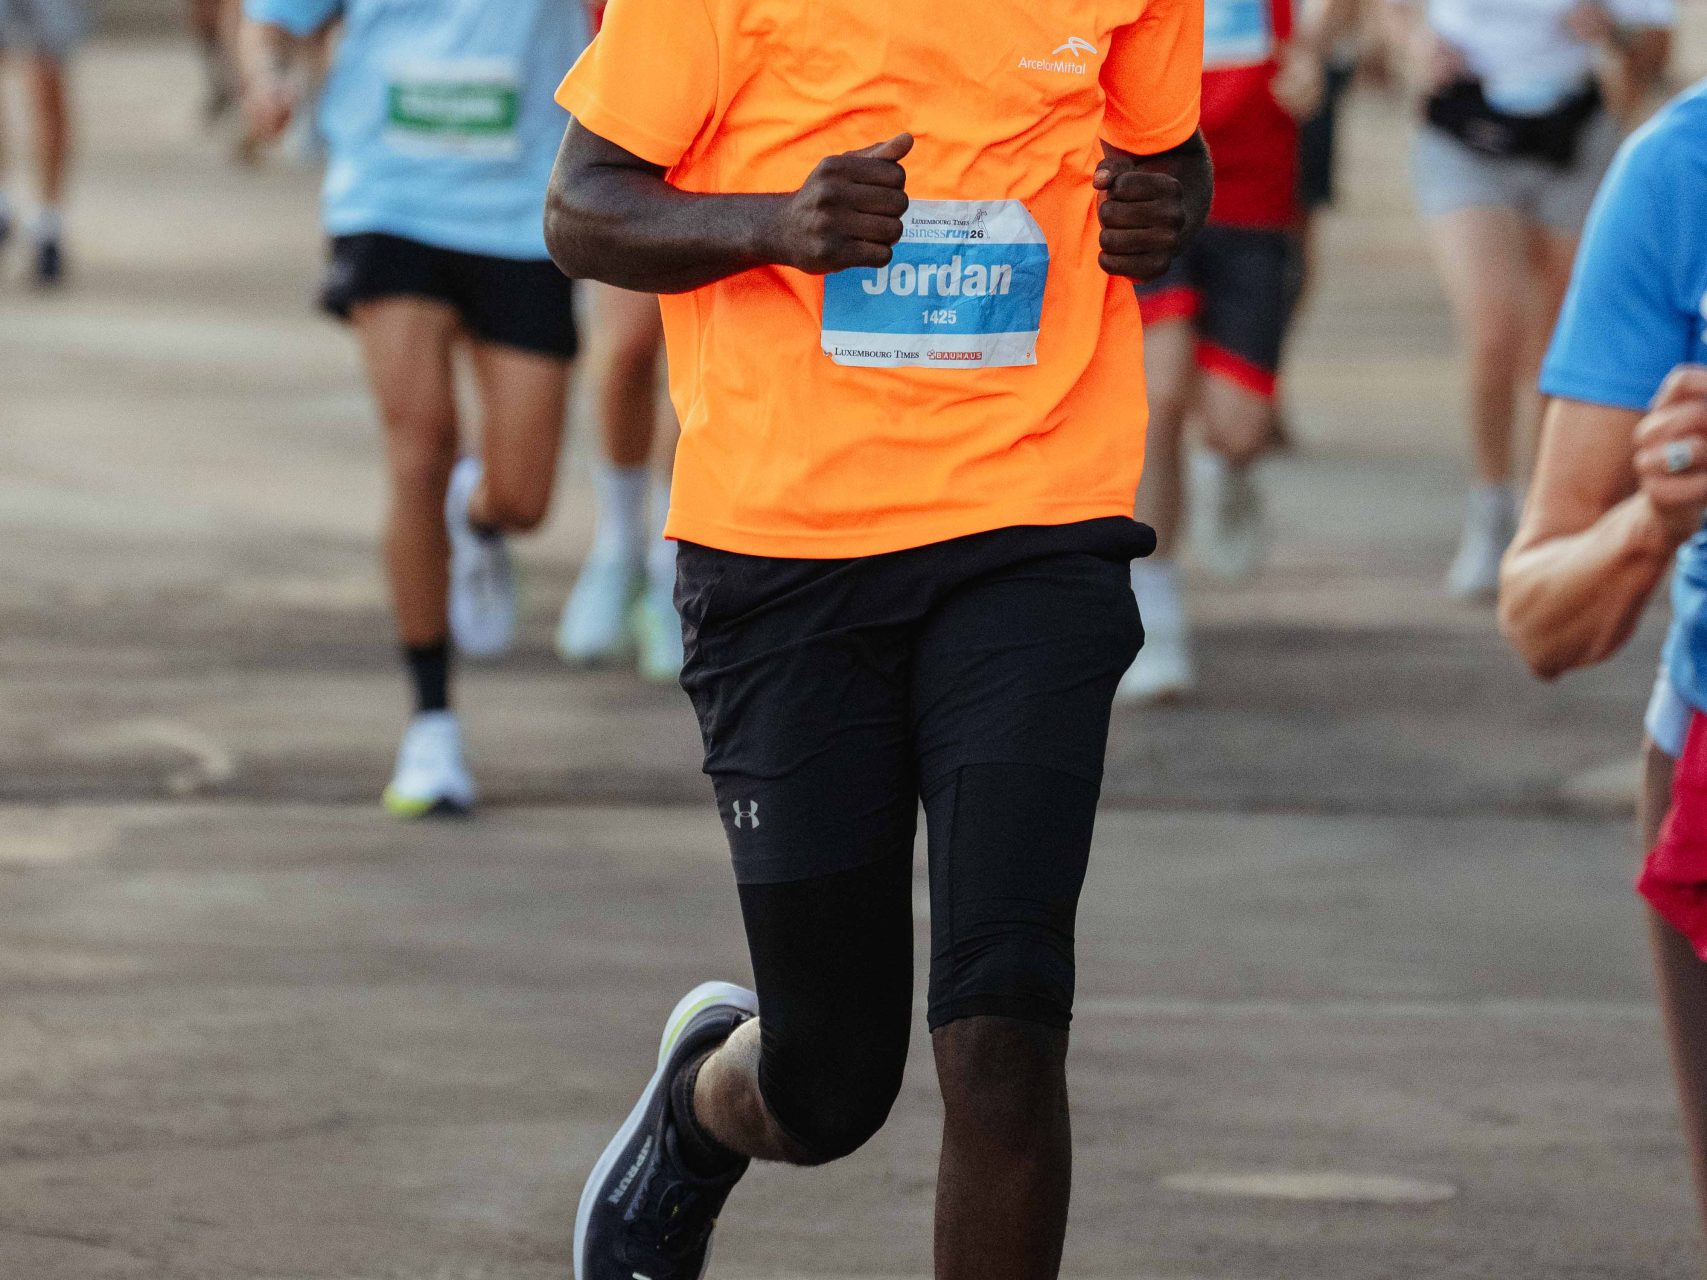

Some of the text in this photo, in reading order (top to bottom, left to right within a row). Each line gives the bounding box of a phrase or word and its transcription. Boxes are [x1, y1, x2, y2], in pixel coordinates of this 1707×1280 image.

[1018, 57, 1086, 75] ArcelorMittal
[902, 225, 984, 239] usinessrun26
[862, 255, 1012, 297] Jordan
[922, 310, 957, 324] 1425
[835, 347, 982, 360] LUXEMBOURG TIMES BAUHAUS
